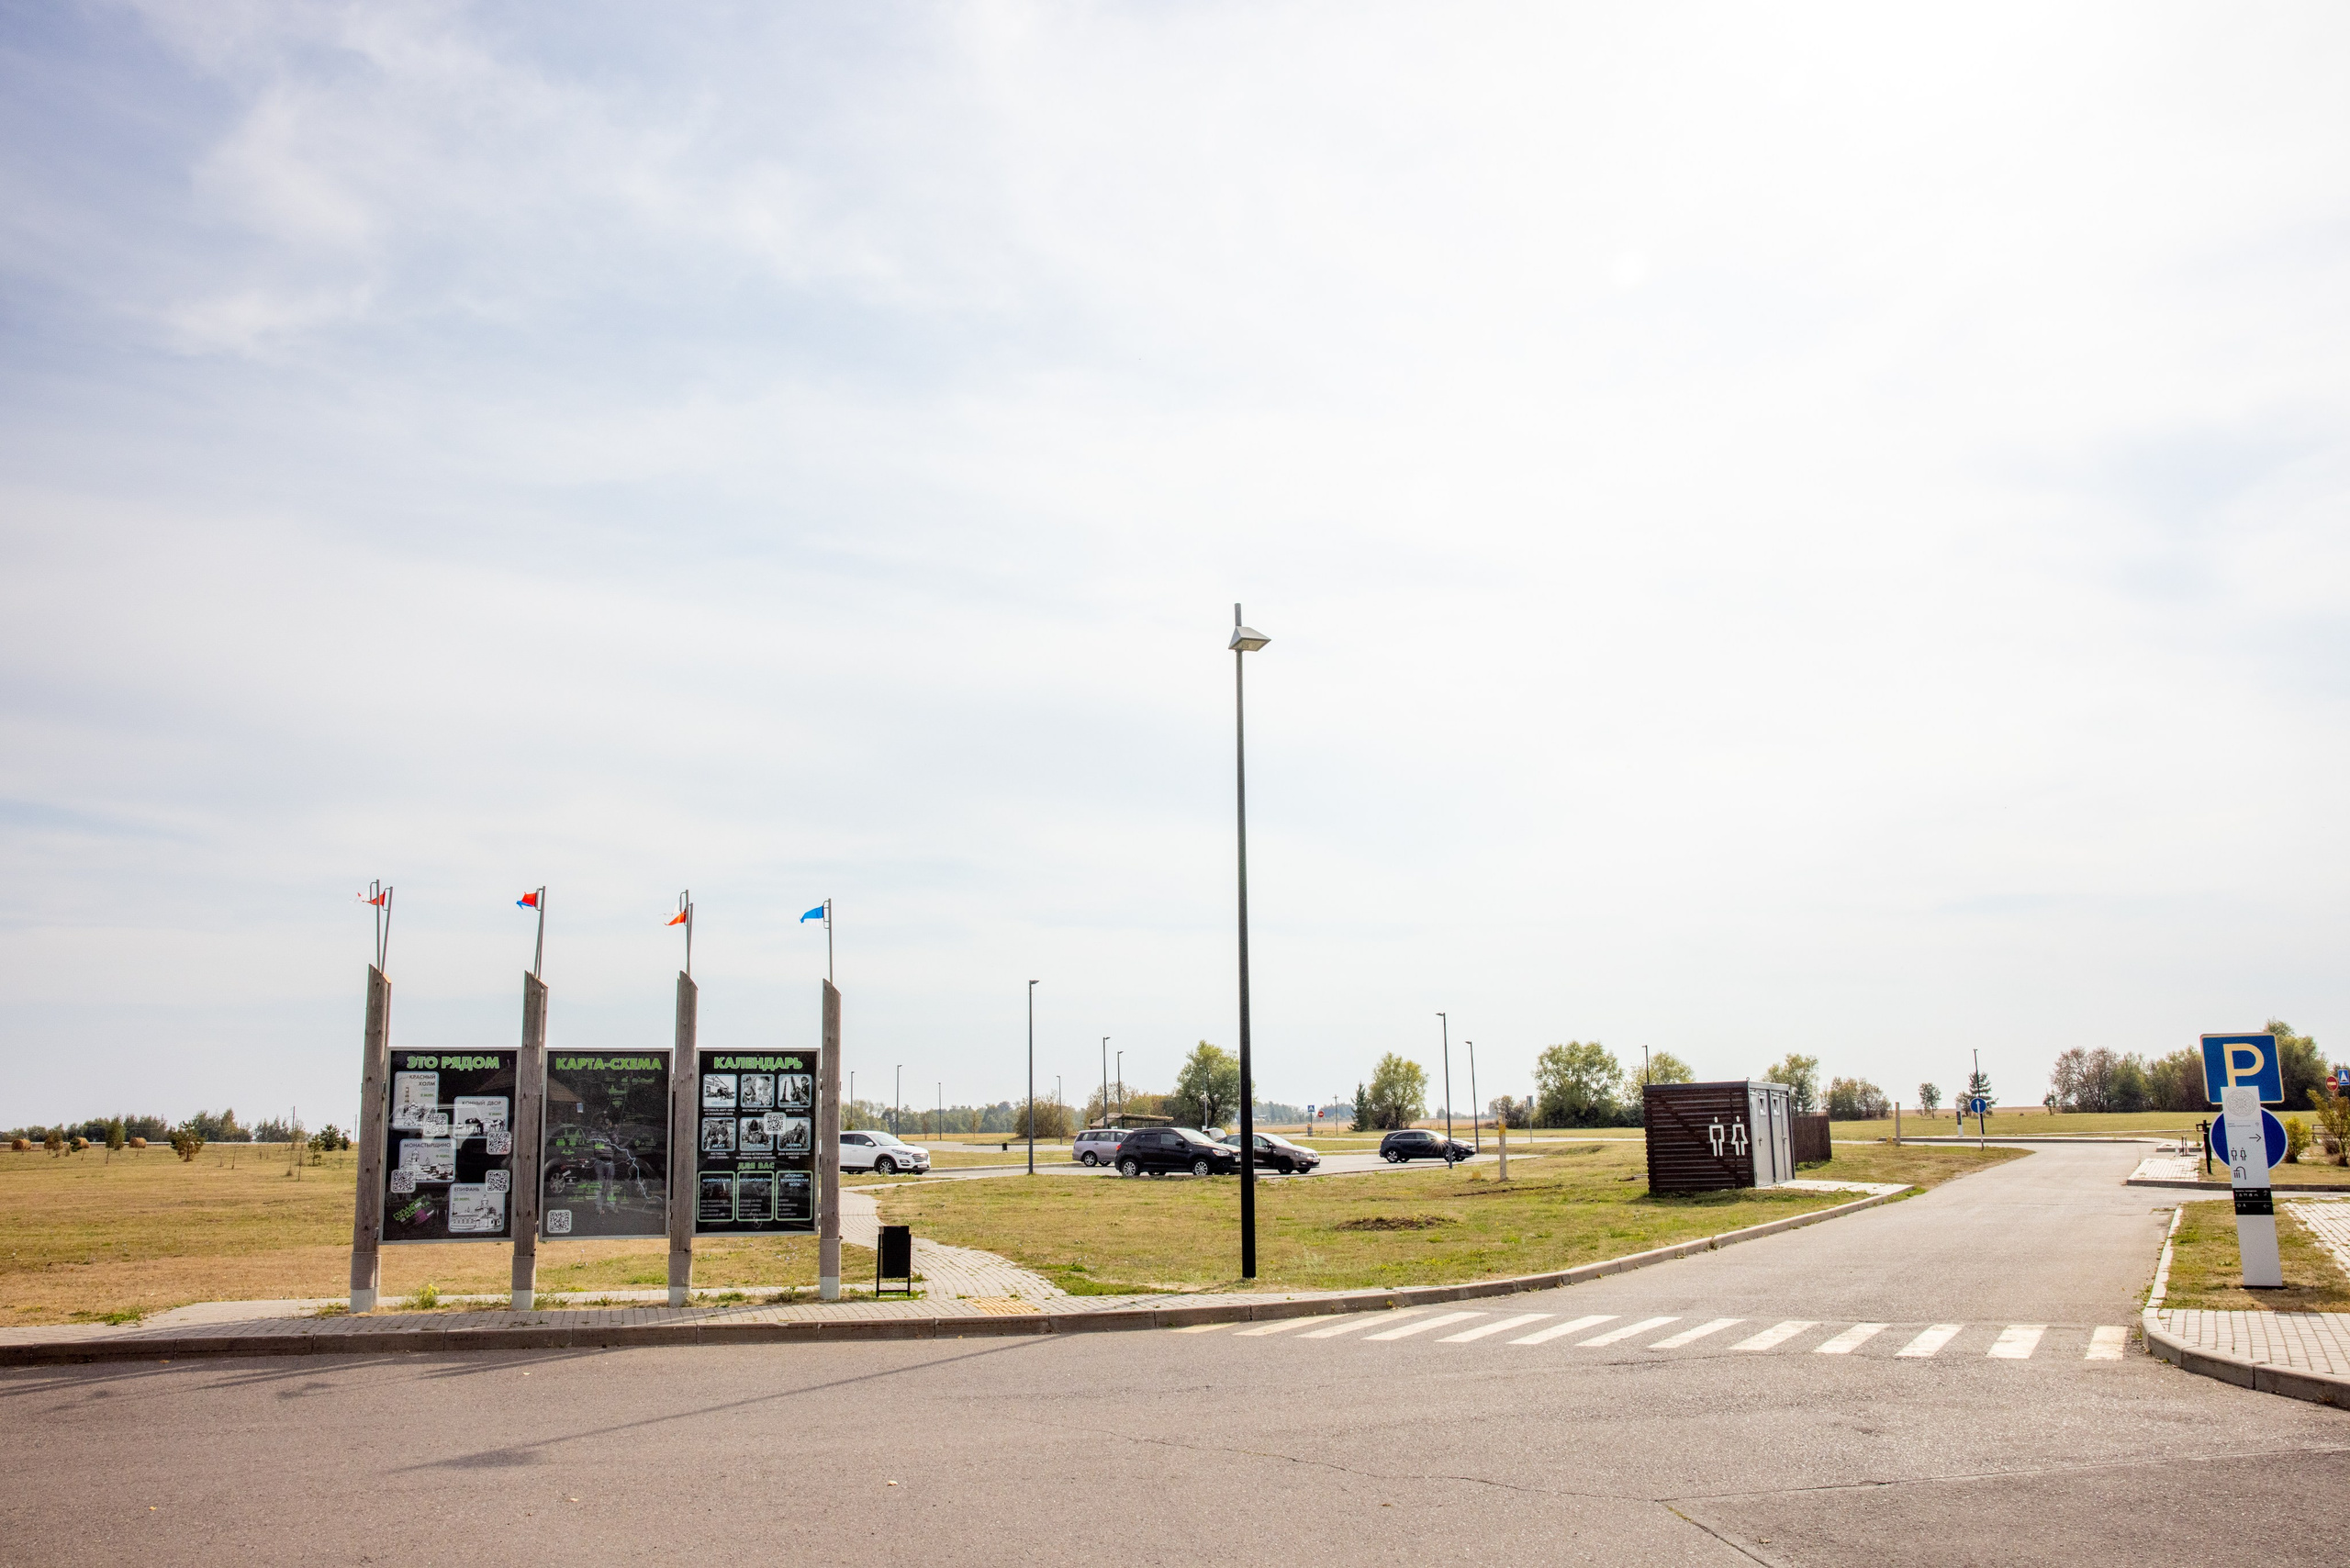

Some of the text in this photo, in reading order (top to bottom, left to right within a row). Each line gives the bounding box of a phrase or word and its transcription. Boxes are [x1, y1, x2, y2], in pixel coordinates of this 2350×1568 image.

[406, 1056, 500, 1071] ЭТО РЯДОМ
[555, 1058, 662, 1070] КАРТА-СХЕМА
[713, 1057, 803, 1071] КАЛЕНДАРЬ
[2222, 1043, 2265, 1087] P
[737, 1162, 755, 1170] ДЛЯ
